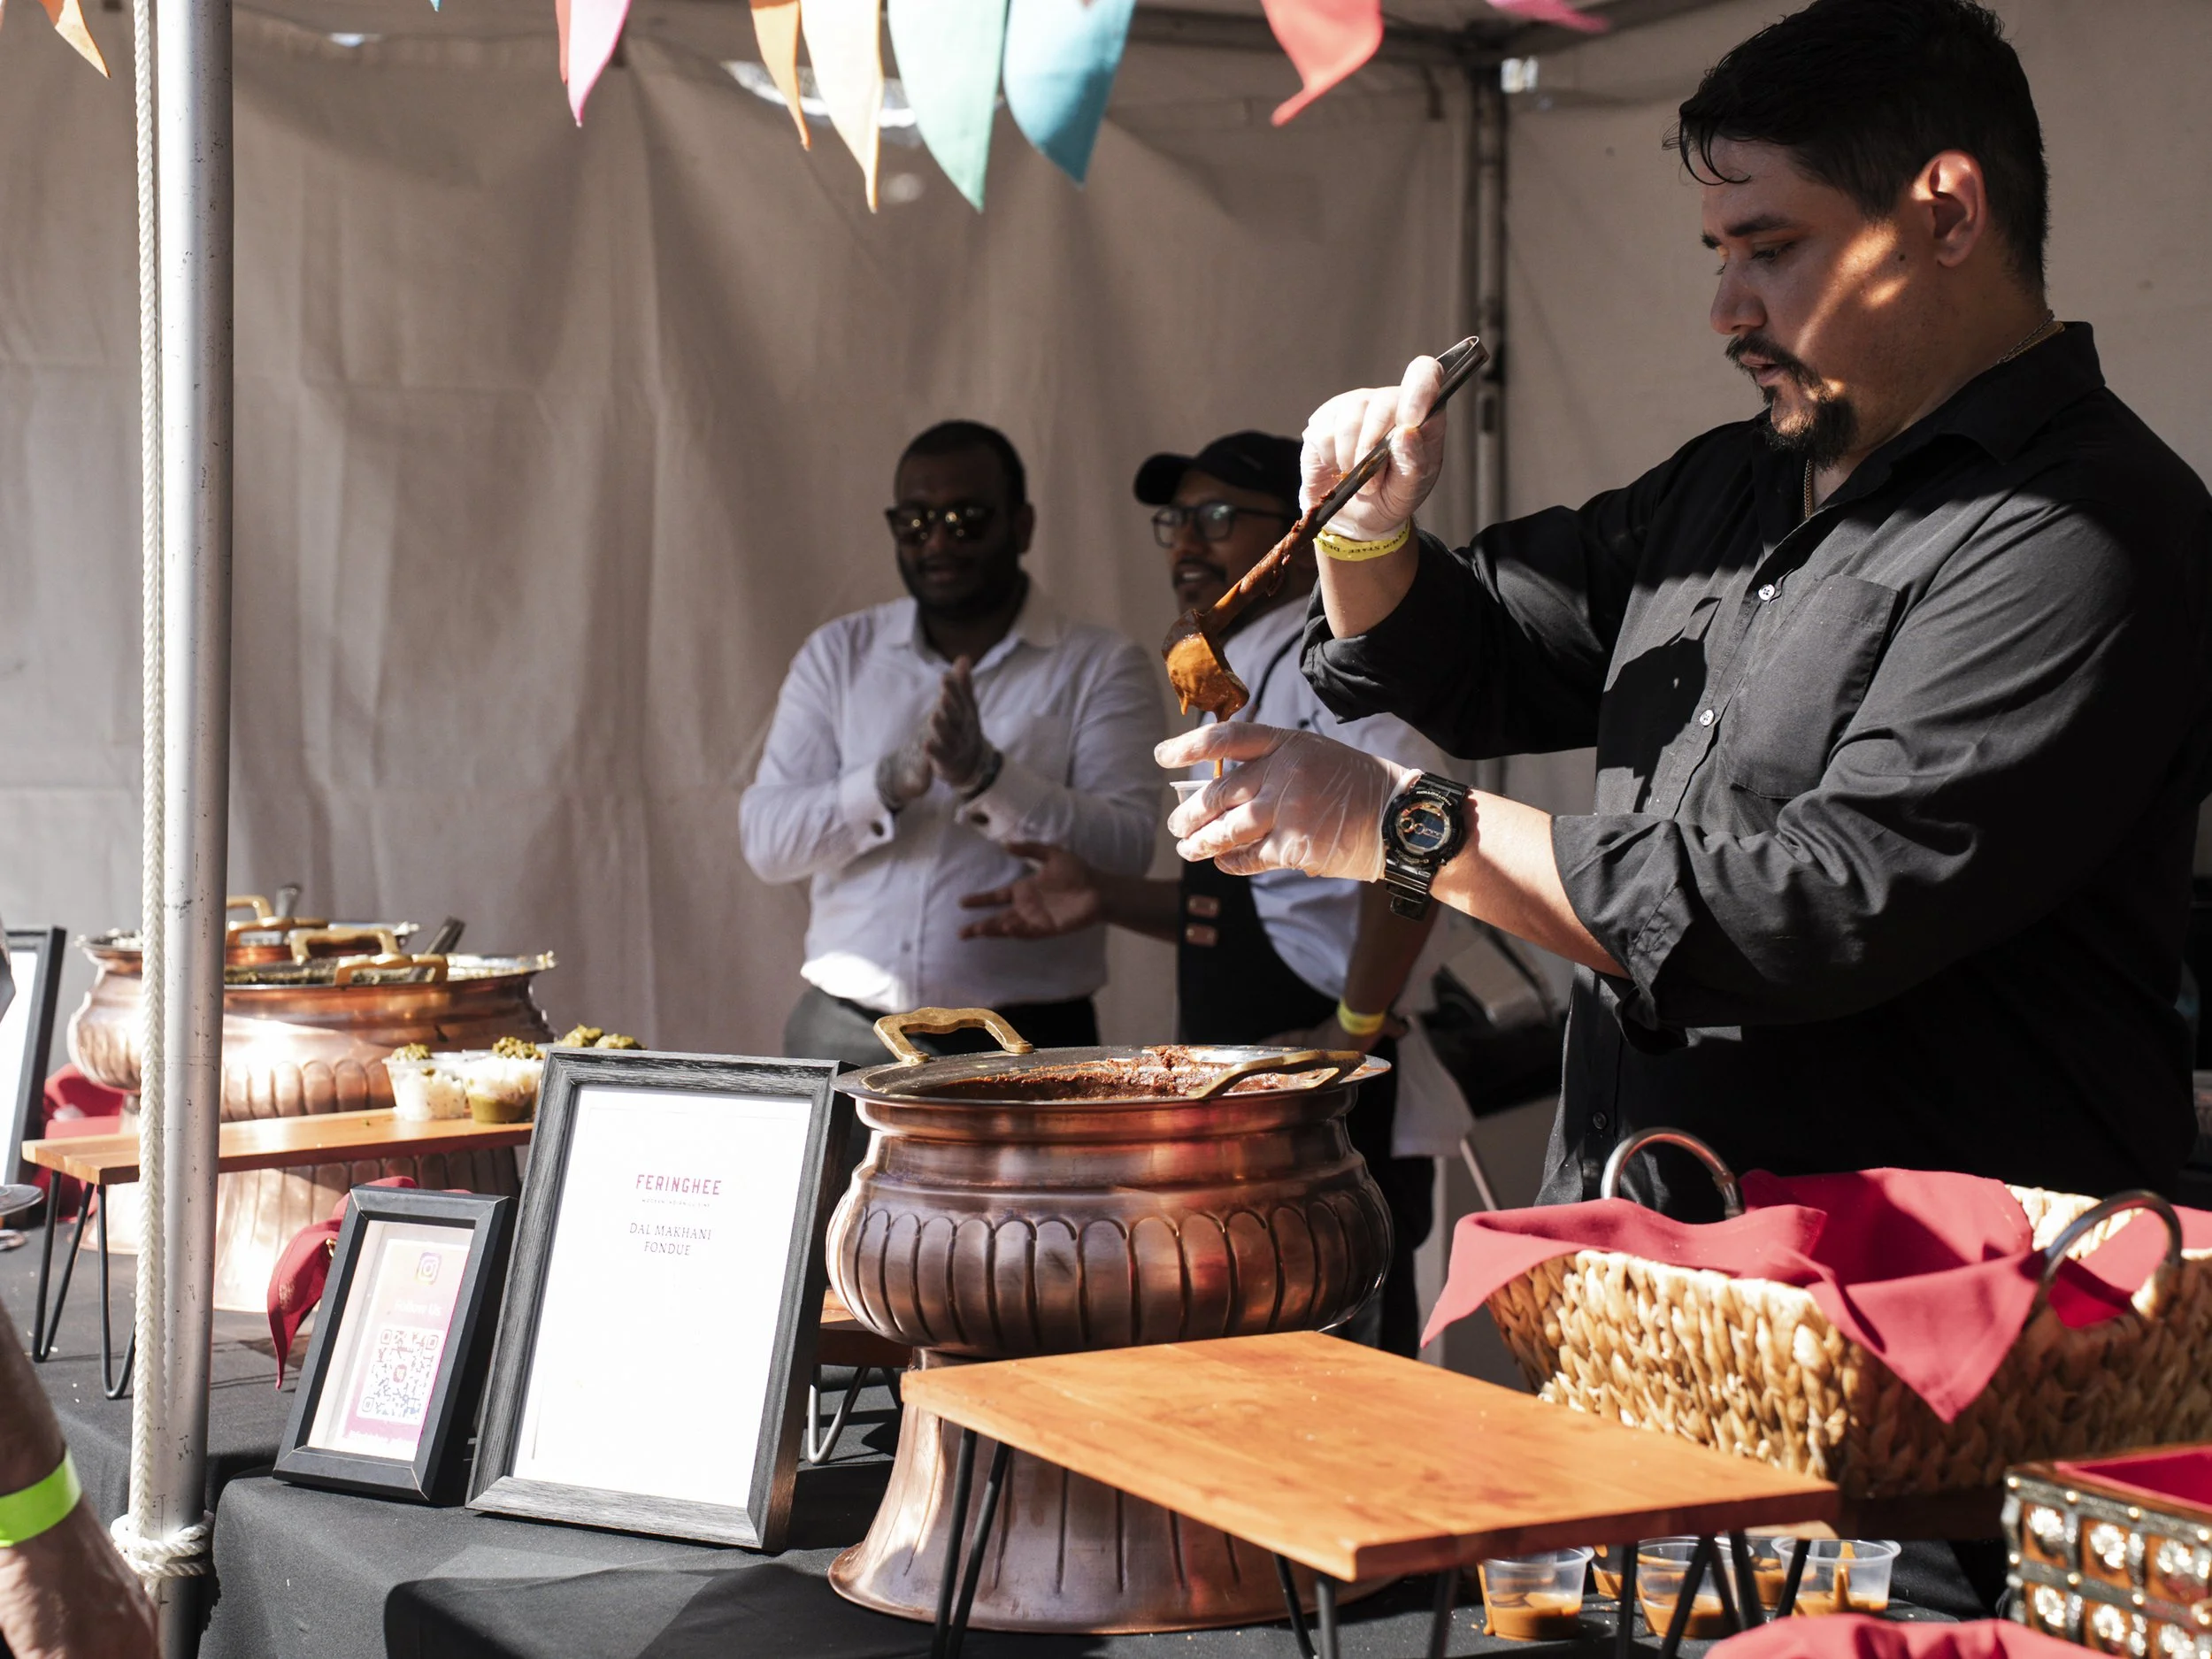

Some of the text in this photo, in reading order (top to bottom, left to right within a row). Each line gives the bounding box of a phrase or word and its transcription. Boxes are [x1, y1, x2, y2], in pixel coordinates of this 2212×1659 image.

[635, 1173, 722, 1195] FERINGHEE
[629, 1222, 712, 1240] DAL MAKHANI
[643, 1240, 691, 1256] FONDUE
